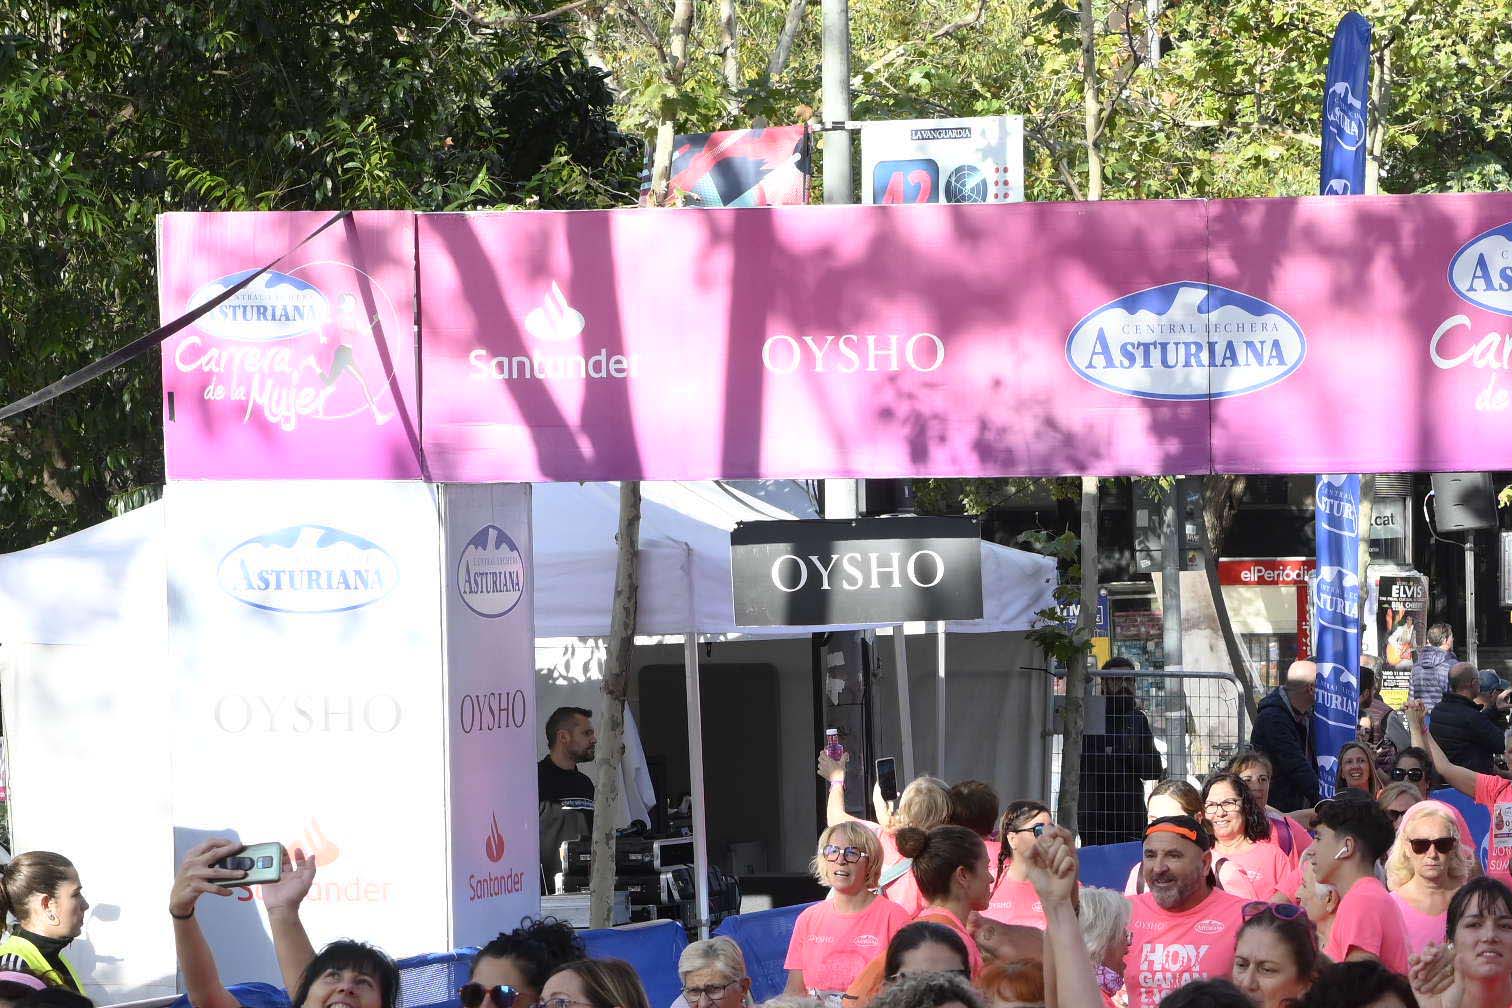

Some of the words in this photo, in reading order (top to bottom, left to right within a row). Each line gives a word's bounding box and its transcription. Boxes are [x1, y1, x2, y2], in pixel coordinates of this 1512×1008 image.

[1122, 322, 1198, 335] CENTRAL
[1203, 321, 1280, 334] LECHERA
[174, 335, 292, 373] Carrera
[468, 348, 640, 380] Santander
[762, 332, 945, 374] OYSHO
[1084, 326, 1288, 370] ASTURIANA
[204, 377, 226, 400] de
[230, 379, 248, 400] la
[244, 366, 337, 431] Mujer
[234, 559, 384, 591] ASTURIANA
[463, 559, 520, 595] ASTURIANA
[771, 550, 945, 592] OYSHO
[1392, 585, 1423, 598] ELVIS
[215, 695, 402, 736] OYSHO
[460, 690, 527, 734] OYSHO
[469, 870, 526, 901] Santander
[1140, 943, 1210, 971] HOY
